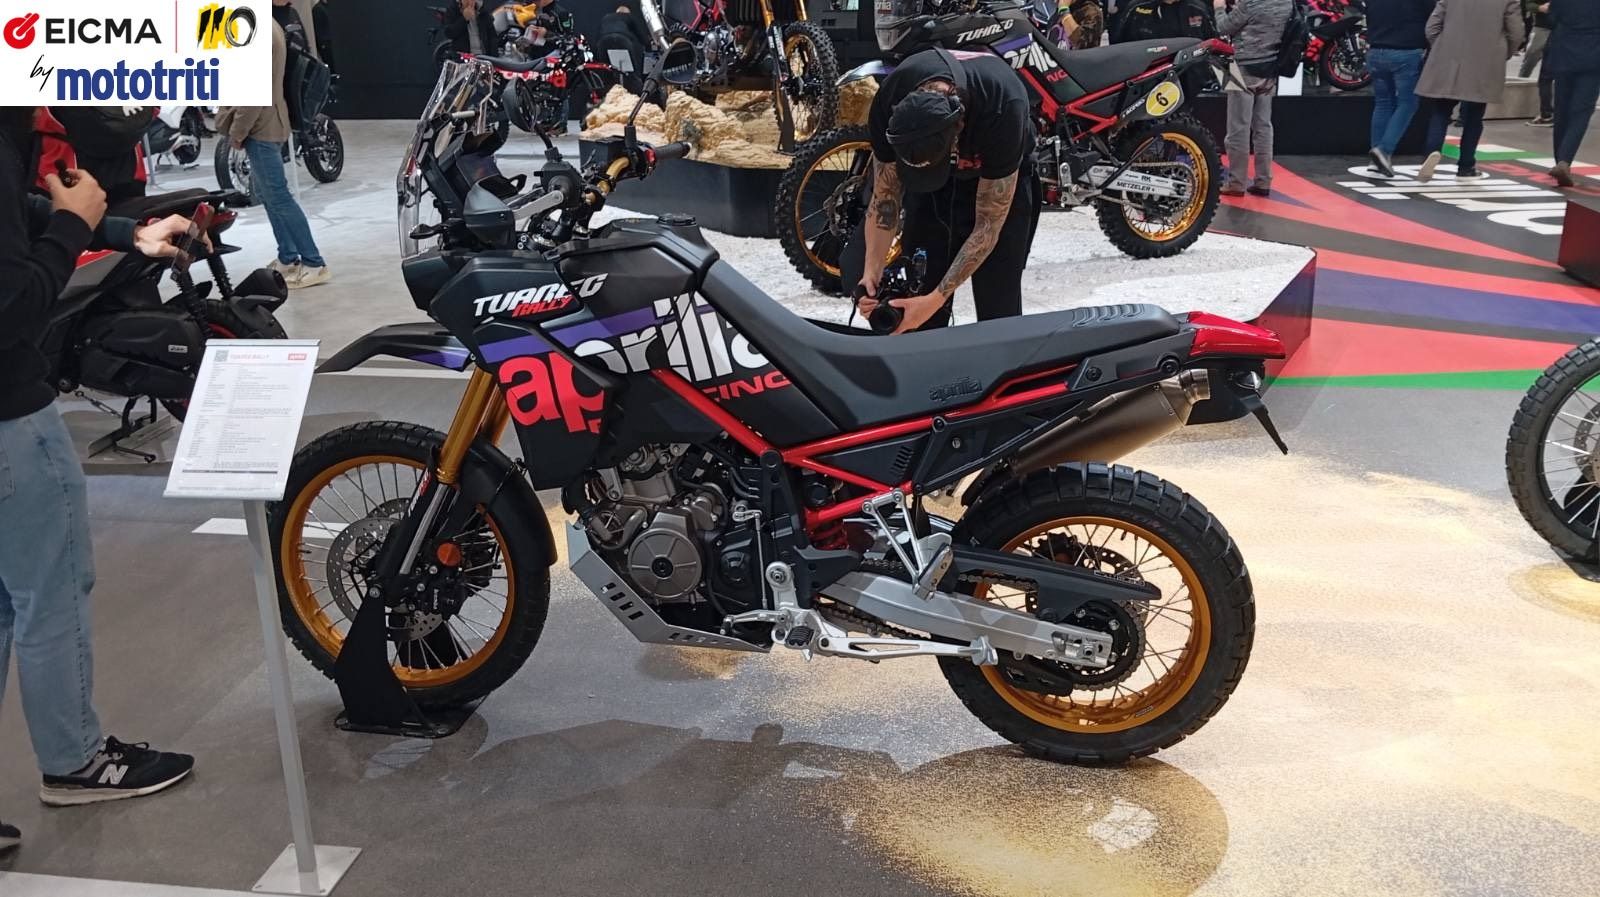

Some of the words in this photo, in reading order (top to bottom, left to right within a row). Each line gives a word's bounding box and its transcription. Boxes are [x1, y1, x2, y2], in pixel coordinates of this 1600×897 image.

[1155, 92, 1169, 107] 6
[511, 295, 575, 318] RALLY
[97, 763, 129, 785] N
